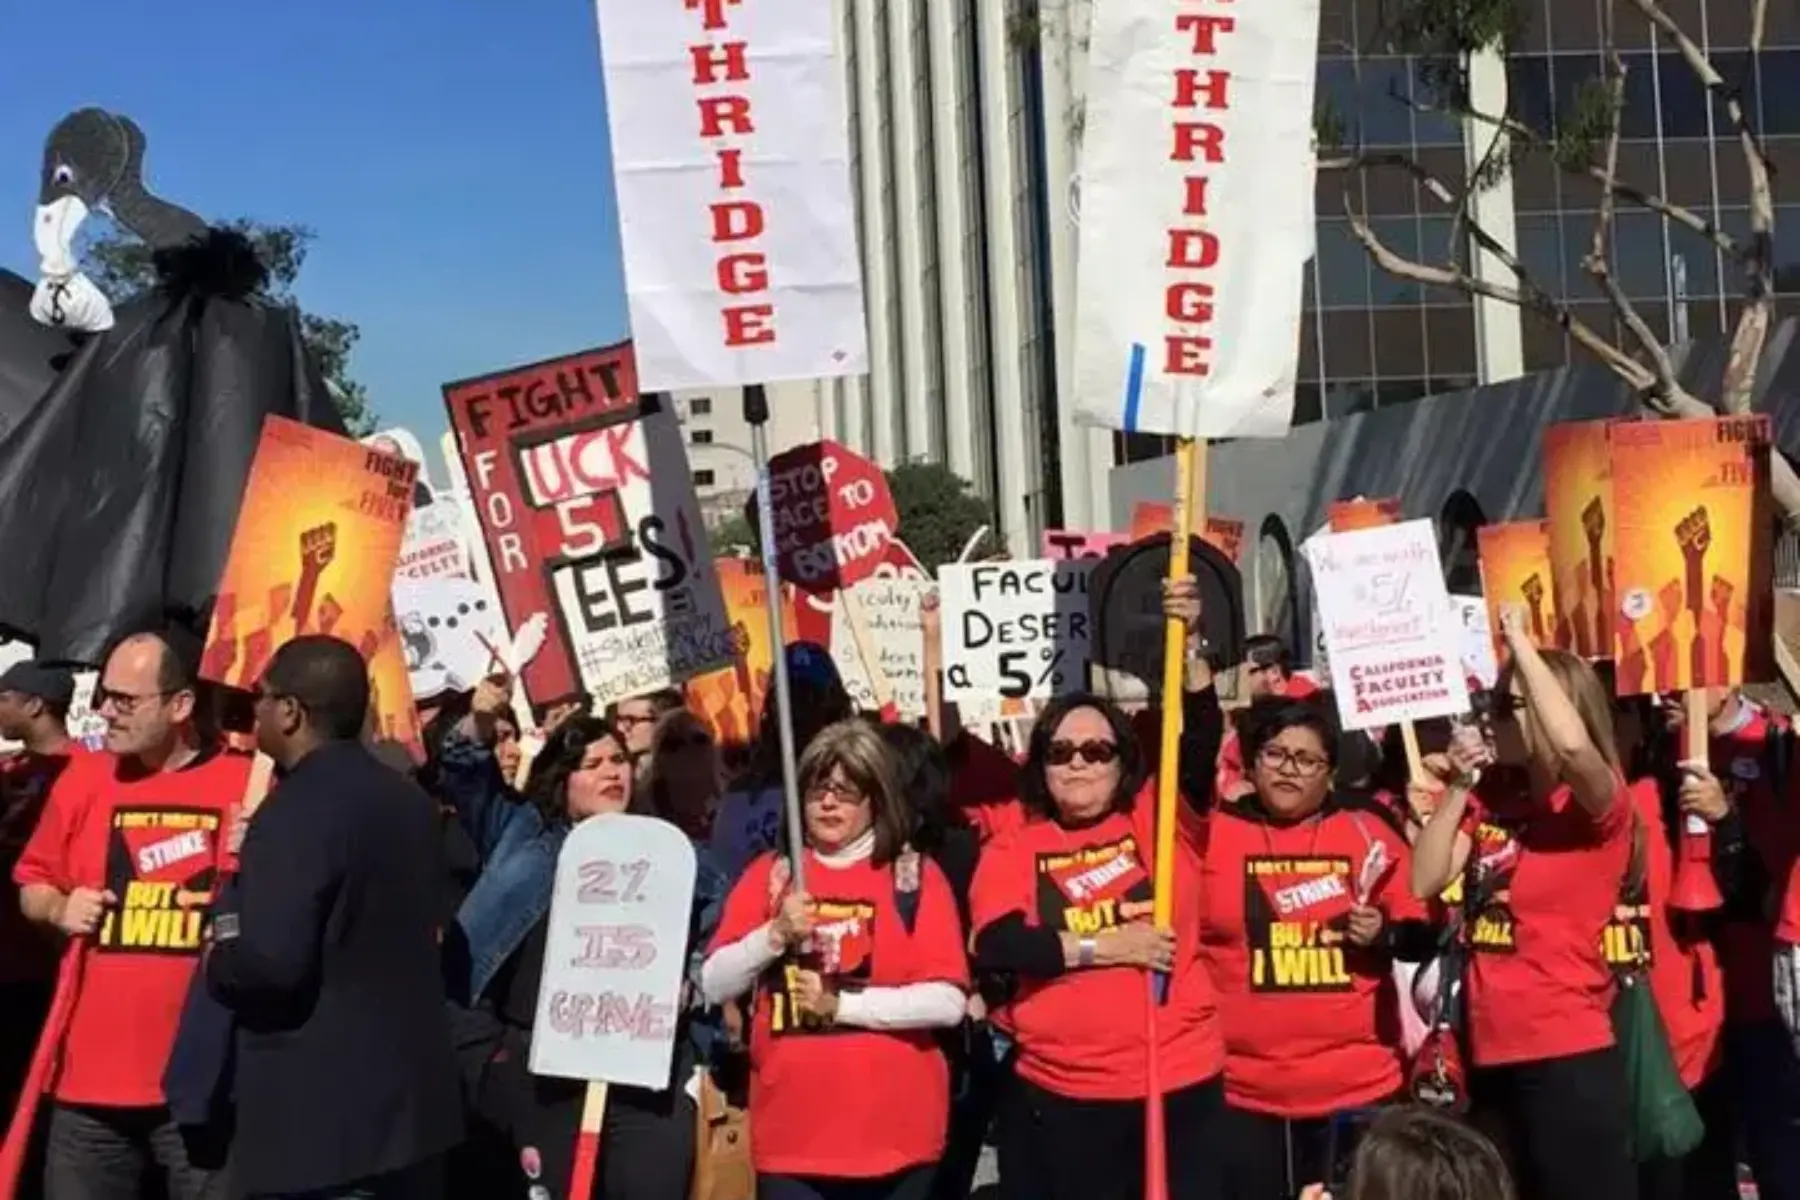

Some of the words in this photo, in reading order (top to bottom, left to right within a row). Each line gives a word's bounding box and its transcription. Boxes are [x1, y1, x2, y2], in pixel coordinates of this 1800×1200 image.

[1162, 0, 1236, 377] THRIDGE
[466, 359, 622, 441] FIGHT
[769, 455, 839, 500] STOP
[837, 478, 875, 510] TO
[473, 449, 529, 573] FOR
[555, 497, 608, 559] 5
[948, 661, 973, 689] a
[997, 649, 1066, 697] 5%
[1349, 654, 1445, 681] CALIFORNIA
[1353, 670, 1445, 697] FACULTY
[1355, 688, 1450, 714] ASSOCIATION
[138, 829, 208, 873] STRIKE
[125, 880, 178, 911] BUT
[1275, 872, 1346, 914] STRIKE
[121, 909, 202, 948] WILL
[1063, 898, 1119, 935] BUT
[570, 923, 659, 970] IS
[1253, 948, 1265, 986] I
[1271, 947, 1351, 986] WILL
[549, 988, 674, 1042] GRAVE
